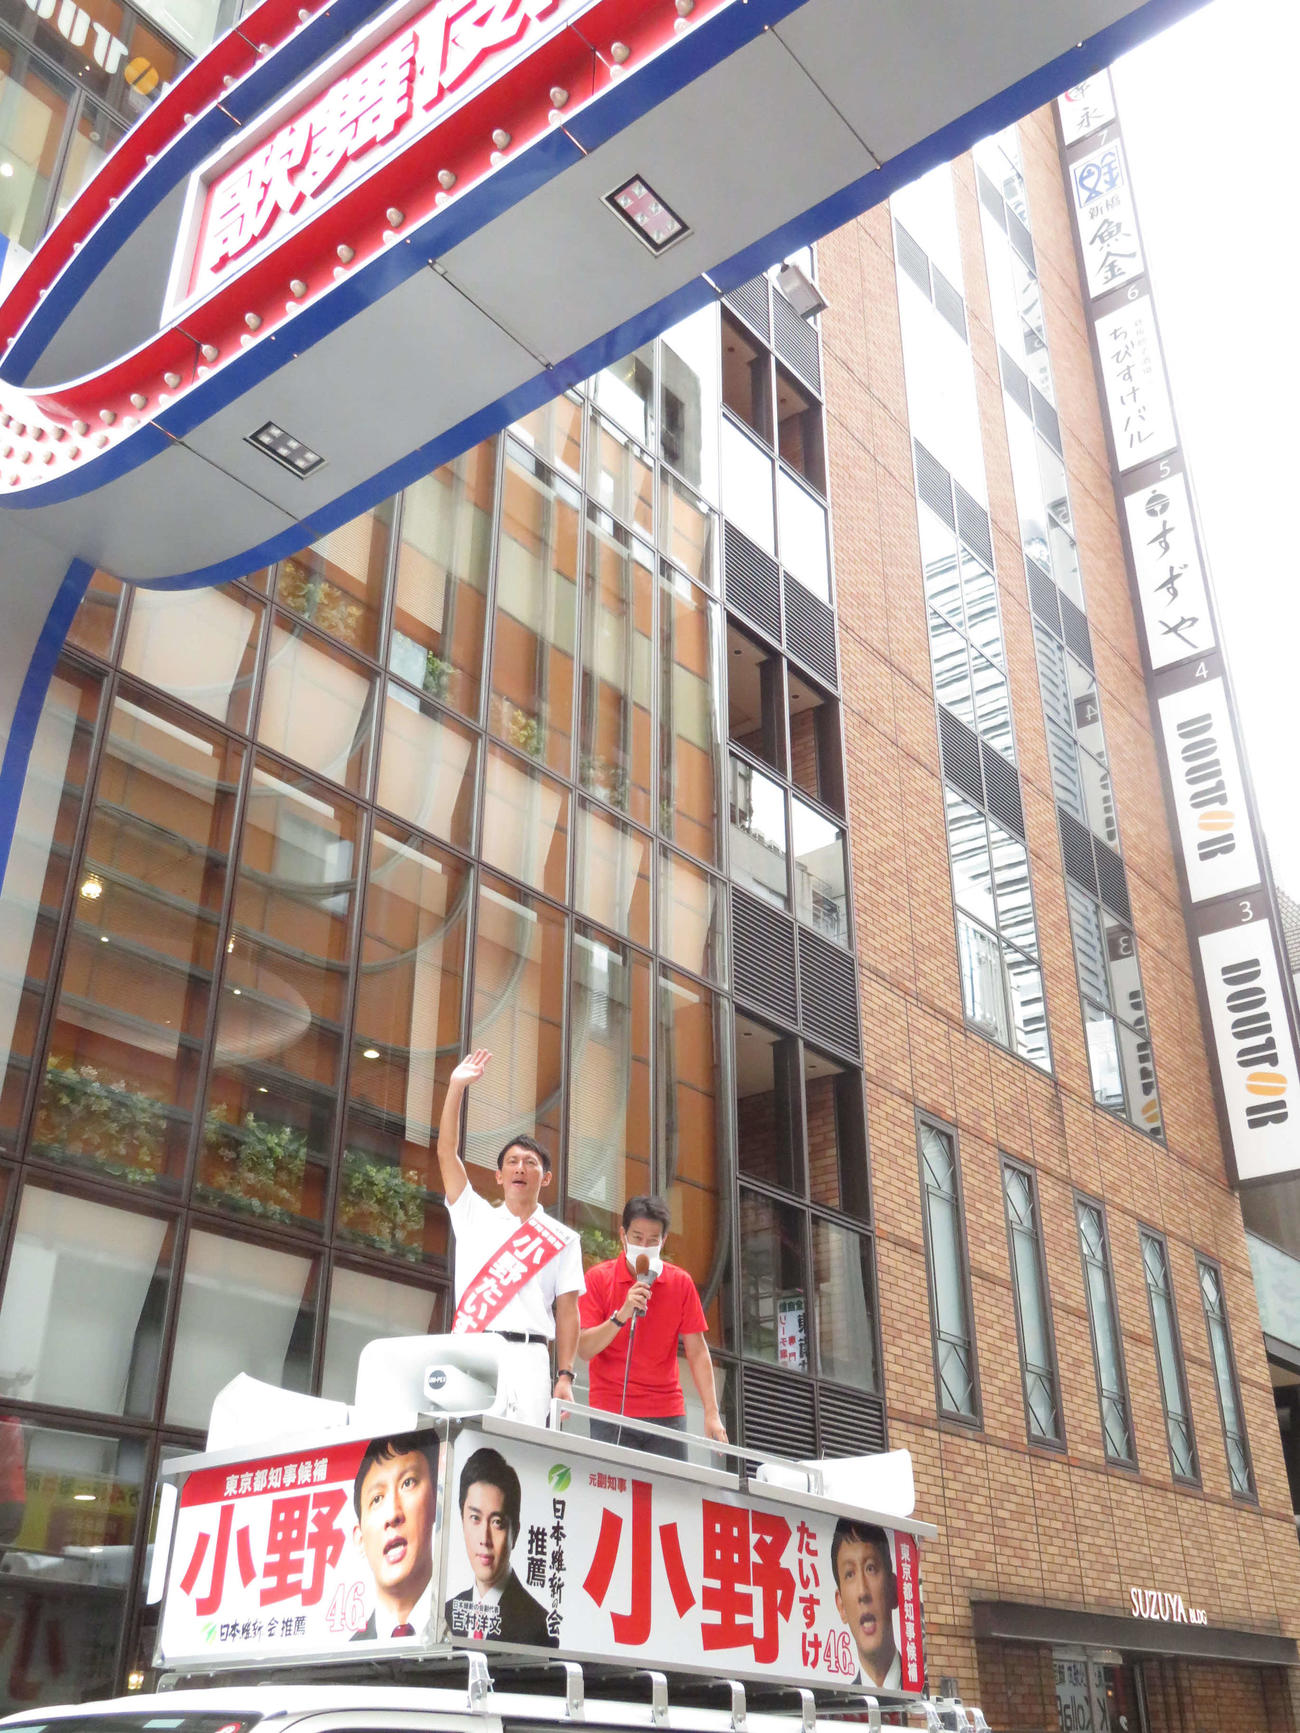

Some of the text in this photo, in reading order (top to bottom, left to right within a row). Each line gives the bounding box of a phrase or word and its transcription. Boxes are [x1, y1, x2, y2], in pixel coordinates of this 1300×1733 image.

[210, 0, 564, 274] 歌舞伎
[1097, 129, 1108, 145] 7
[1089, 218, 1136, 285] 魚金
[1127, 285, 1139, 300] 6
[1110, 326, 1154, 449] ちびすけバル
[1159, 460, 1171, 477] 5
[1147, 519, 1199, 649] すずや
[1195, 661, 1208, 679] 4
[1176, 712, 1236, 862] DOUTOR
[1239, 901, 1253, 922] 3
[1221, 957, 1290, 1131] DOUTOR
[224, 1458, 328, 1497] 東京都知事候補
[180, 1488, 349, 1616] 小野
[526, 1525, 547, 1588] 推薦
[548, 1498, 567, 1636] 日本維新の会
[583, 1479, 797, 1664] 小野
[796, 1520, 823, 1669] たいすけ
[452, 1609, 502, 1635] 吉村洋文
[900, 1543, 918, 1683] 東京都知事候補
[1130, 1587, 1208, 1625] SUZUYA BLDG
